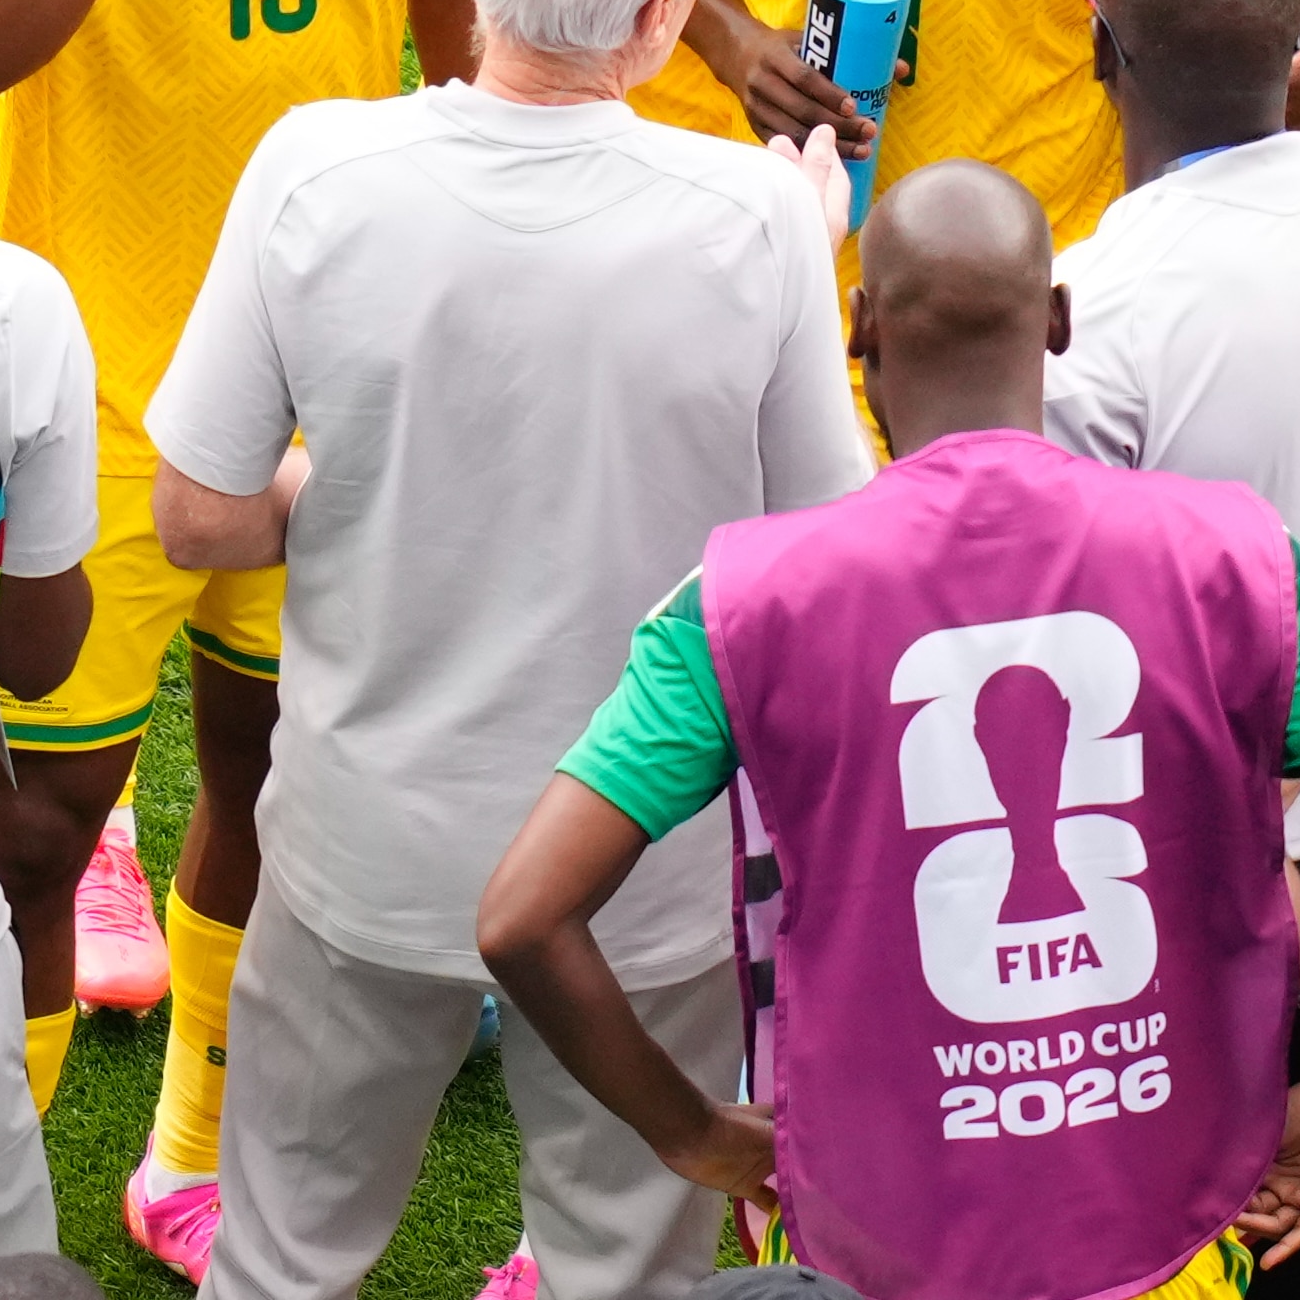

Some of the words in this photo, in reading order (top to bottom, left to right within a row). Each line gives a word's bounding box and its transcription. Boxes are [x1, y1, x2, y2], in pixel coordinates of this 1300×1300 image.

[884, 10, 898, 24] 4
[18, 704, 69, 712] ASSOCIATION
[996, 932, 1103, 985] FIFA
[933, 1031, 1086, 1078] WORLD
[1091, 1011, 1167, 1057] CUP
[939, 1055, 1172, 1140] 2026
